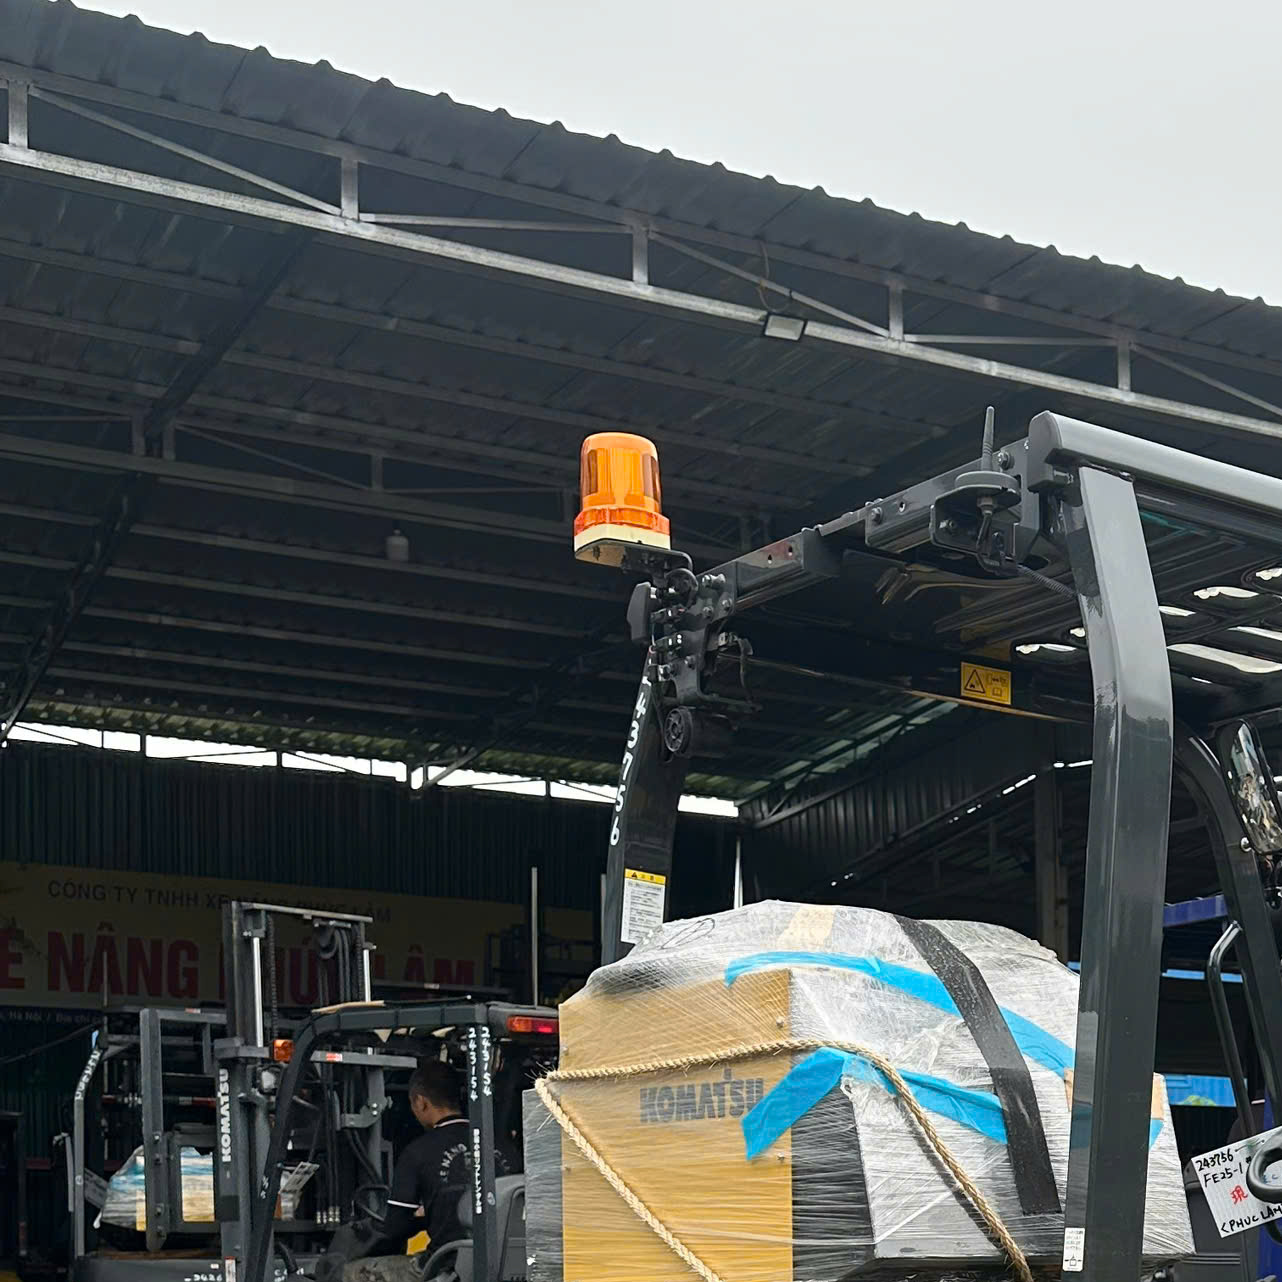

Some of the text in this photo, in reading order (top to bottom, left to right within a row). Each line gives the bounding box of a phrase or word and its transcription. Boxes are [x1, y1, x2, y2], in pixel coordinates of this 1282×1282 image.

[145, 888, 201, 907] TNHH
[47, 921, 200, 999] NÂNG
[218, 1067, 232, 1163] KOMATSU
[639, 1067, 764, 1124] KOMATSU
[1195, 1148, 1234, 1172] 243756
[1203, 1162, 1243, 1188] FE25-1
